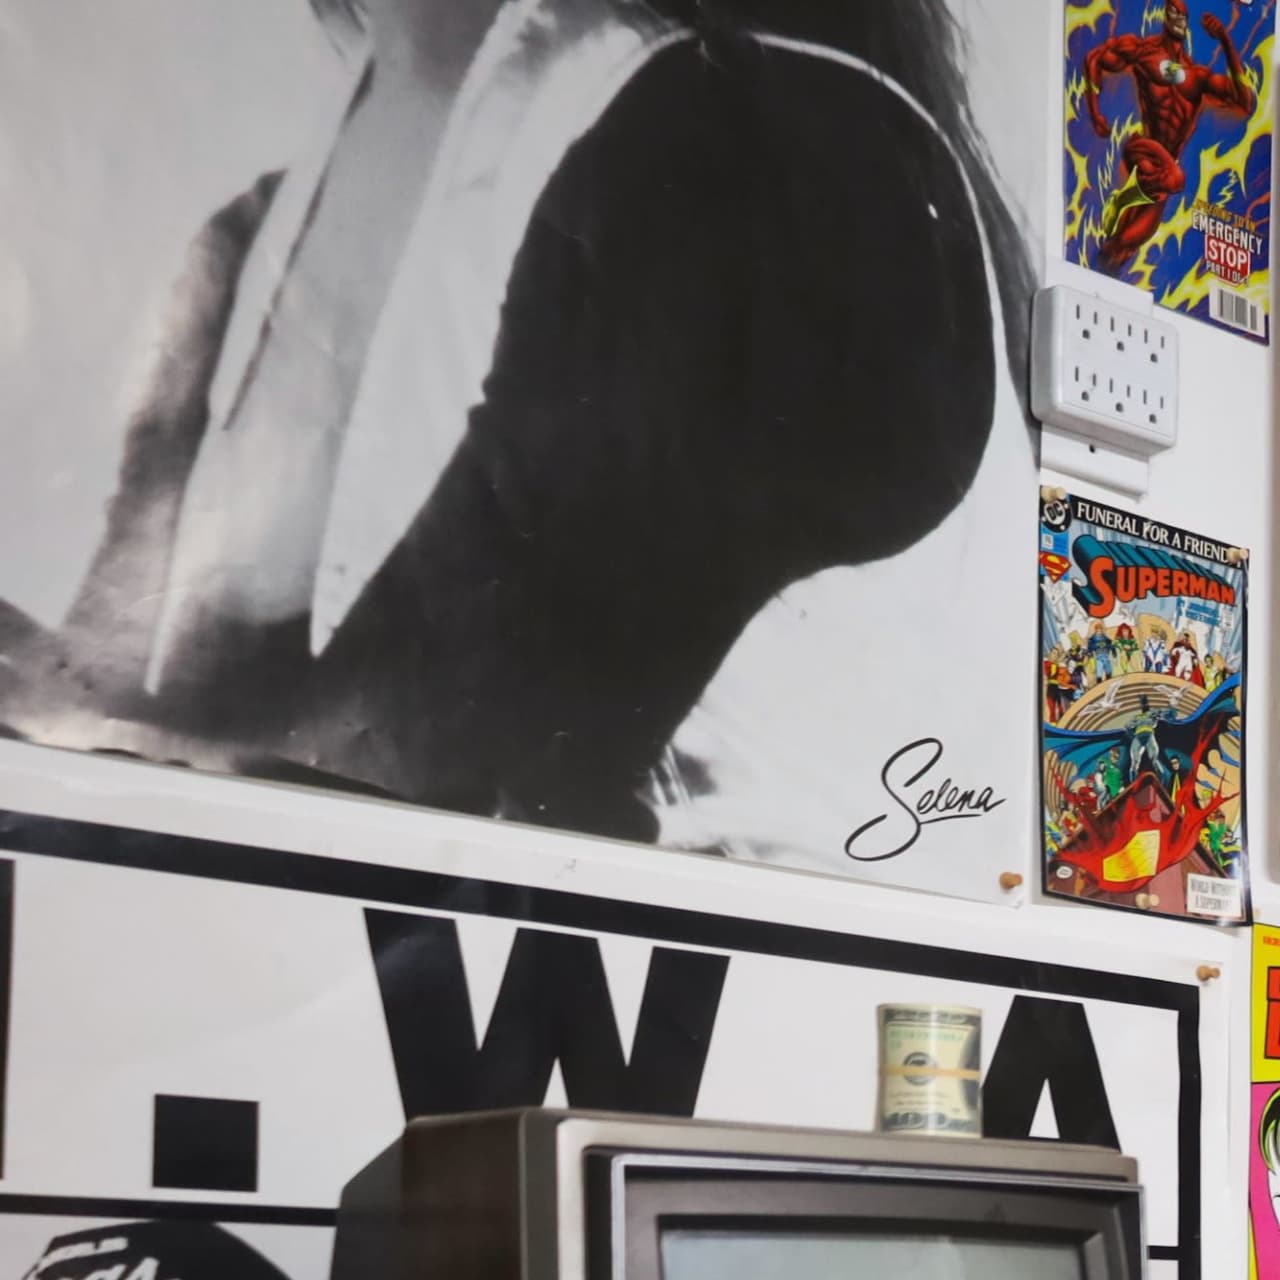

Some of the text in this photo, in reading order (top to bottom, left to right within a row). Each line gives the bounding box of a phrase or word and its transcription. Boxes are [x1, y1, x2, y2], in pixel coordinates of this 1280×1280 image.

[1192, 211, 1263, 256] EMERGENCY
[1208, 238, 1248, 271] STOP
[1076, 500, 1139, 536] FUNERAL
[1142, 519, 1170, 545] FOR
[1171, 532, 1182, 549] A
[1088, 556, 1237, 618] SUPERMAN
[844, 737, 1008, 862] Selena
